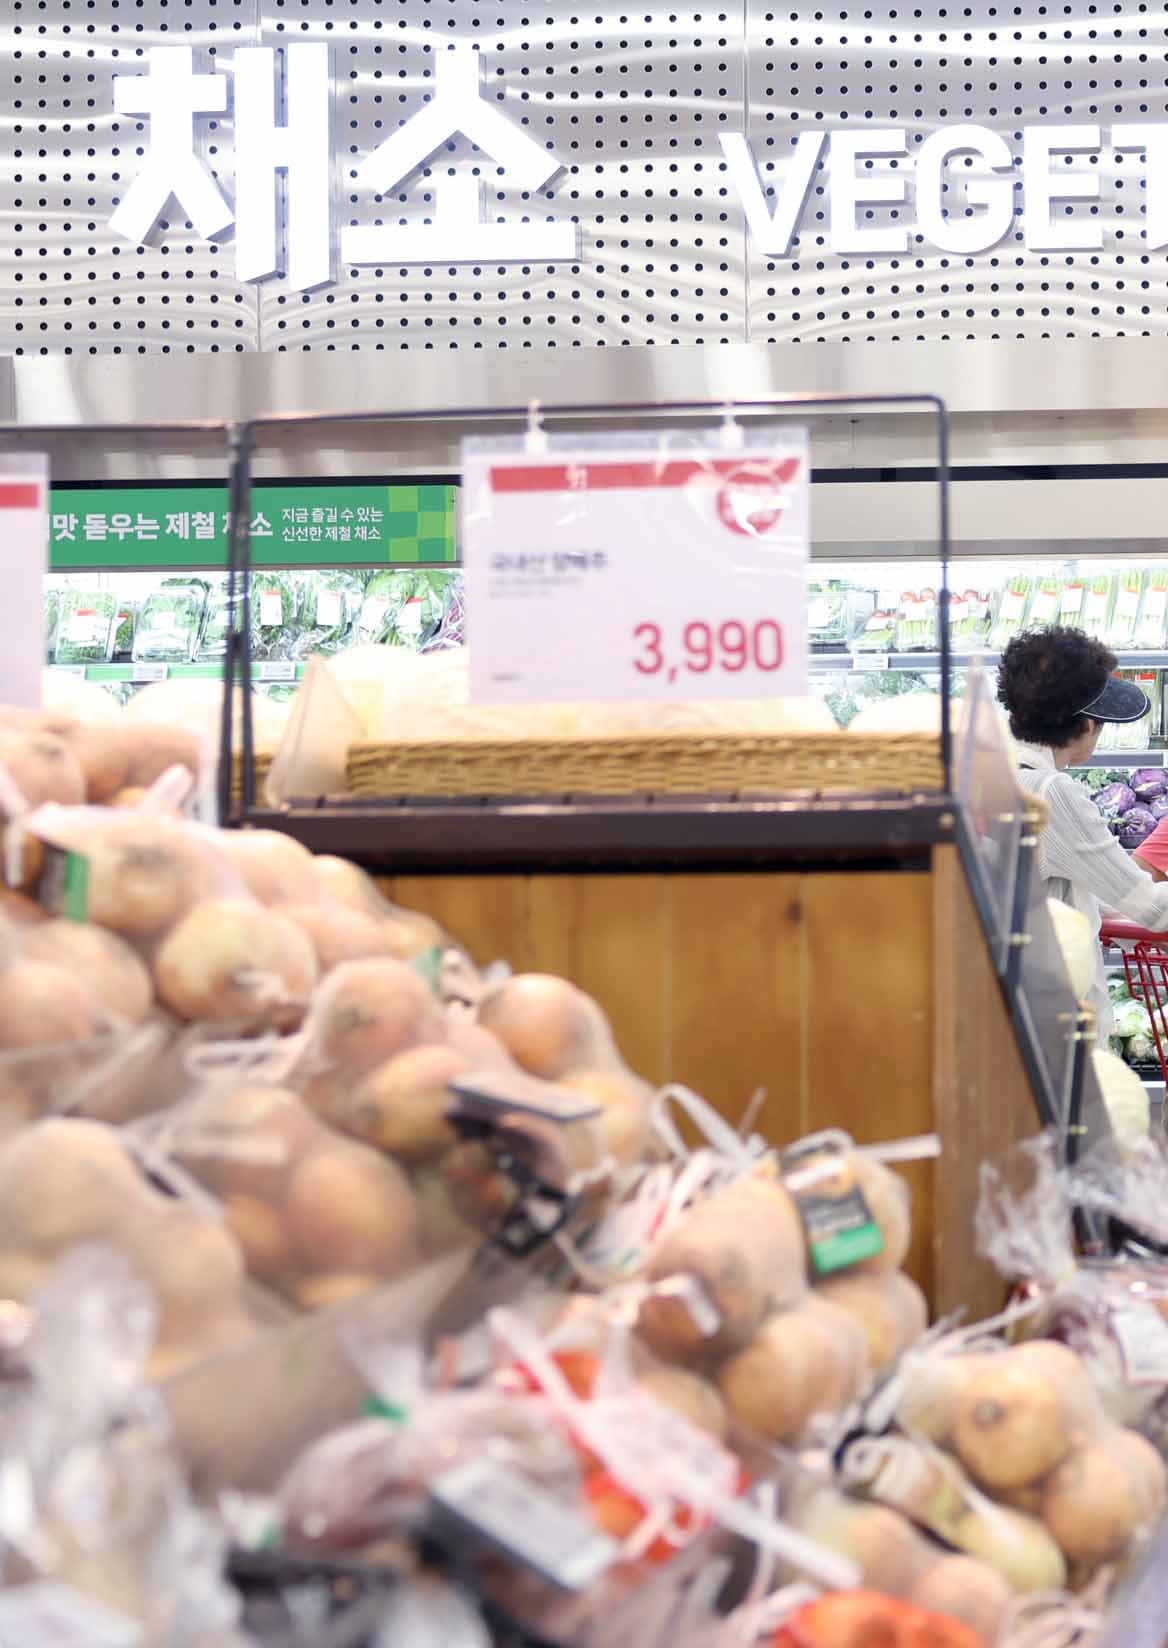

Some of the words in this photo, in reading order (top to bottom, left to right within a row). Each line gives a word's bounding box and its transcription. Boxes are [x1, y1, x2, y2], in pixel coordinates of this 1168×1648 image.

[107, 42, 581, 291] 채소
[47, 513, 77, 541] 맛
[83, 513, 161, 541] 돋우는
[166, 511, 216, 540] 제철
[281, 508, 310, 523] 지금
[311, 508, 338, 523] 즐길
[340, 508, 354, 522] 수
[356, 507, 385, 522] 있는
[281, 527, 322, 543] 신선한
[324, 527, 352, 542] 제철
[354, 526, 382, 541] 채소
[632, 619, 784, 684] 3,990
